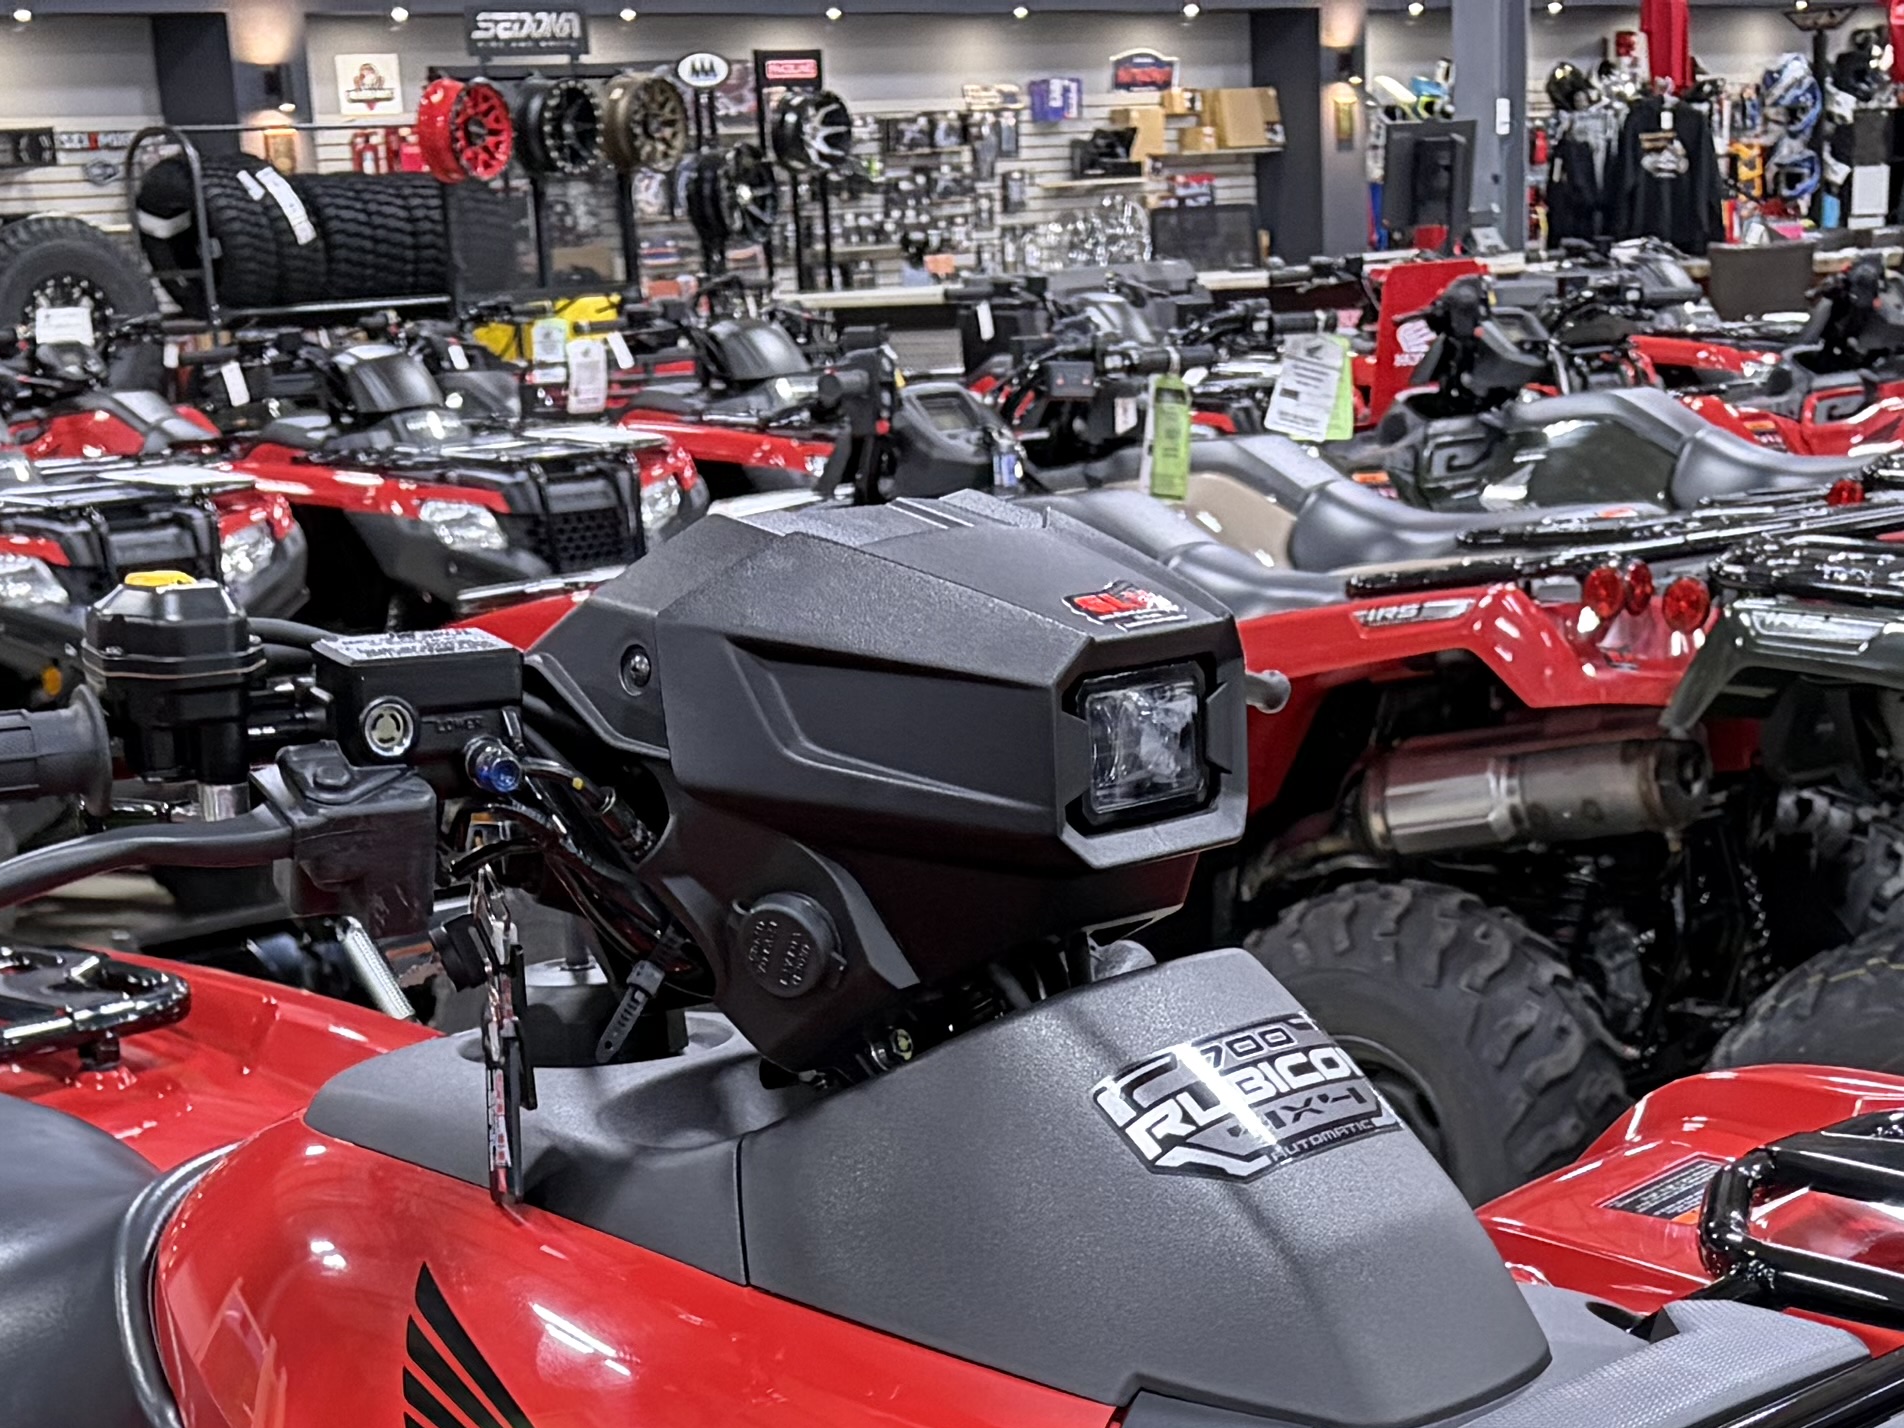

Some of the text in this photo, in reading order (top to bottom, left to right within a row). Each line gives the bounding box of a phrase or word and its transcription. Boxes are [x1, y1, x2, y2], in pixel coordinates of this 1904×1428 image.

[470, 11, 582, 39] SEDONA
[1200, 1026, 1298, 1069] 700
[1270, 1118, 1375, 1163] AUTOMATIC
